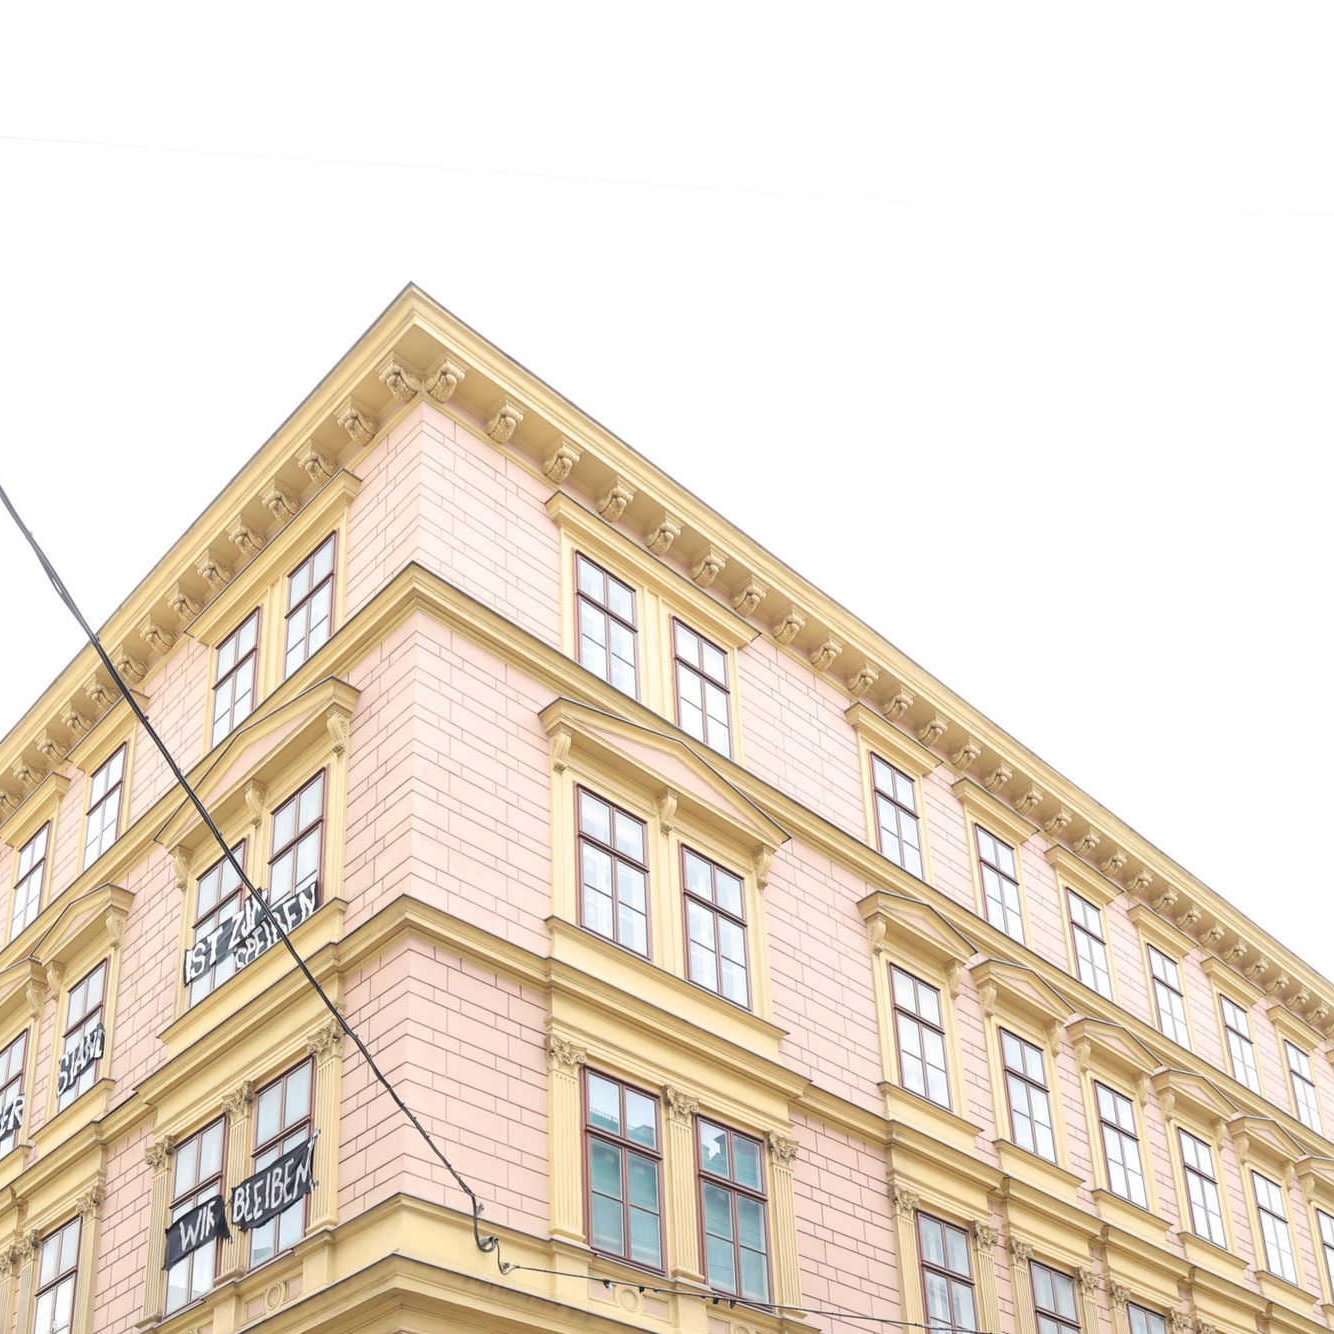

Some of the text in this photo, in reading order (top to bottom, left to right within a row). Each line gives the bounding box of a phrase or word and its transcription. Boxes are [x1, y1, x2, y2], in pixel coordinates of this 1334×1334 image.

[185, 926, 223, 983] IST
[232, 1140, 312, 1223] BLEIBEN
[179, 1200, 216, 1251] WIR
